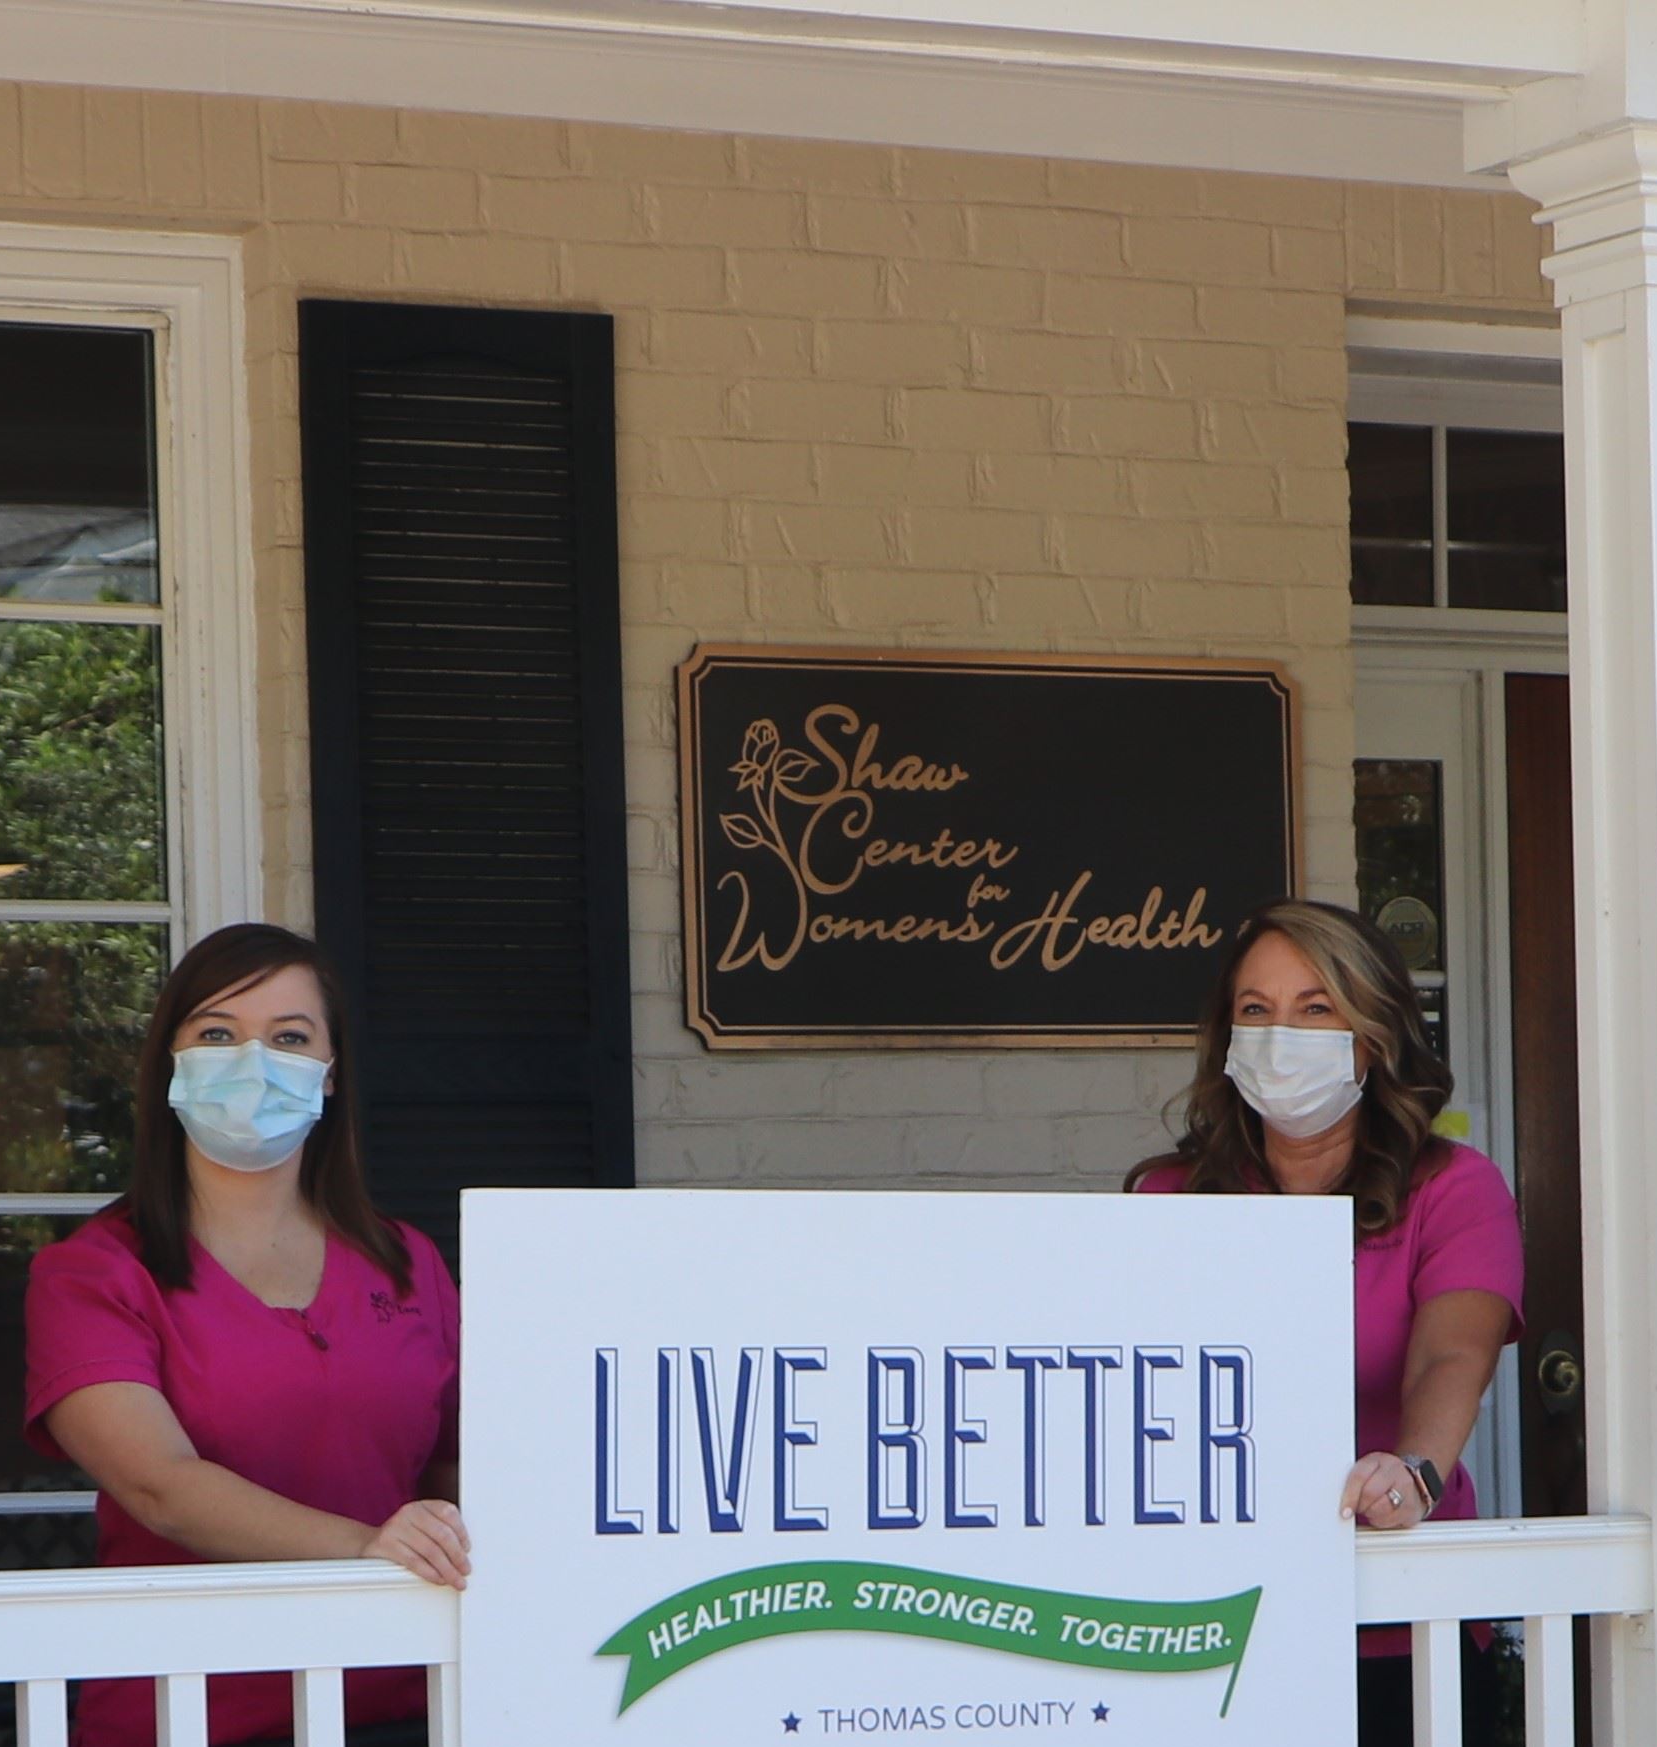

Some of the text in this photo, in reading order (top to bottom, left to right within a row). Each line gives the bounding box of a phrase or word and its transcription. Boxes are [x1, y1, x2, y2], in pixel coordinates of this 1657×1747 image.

[774, 704, 969, 804] Shaw
[800, 789, 1019, 895] Center
[967, 873, 1011, 909] for
[989, 869, 1223, 972] Health
[594, 1345, 1257, 1536] LIVE BETTER
[647, 1580, 1232, 1660] HEALTHIER. STRONGER. TOGETHER.
[818, 1701, 1076, 1733] THOMAS COUNTY
